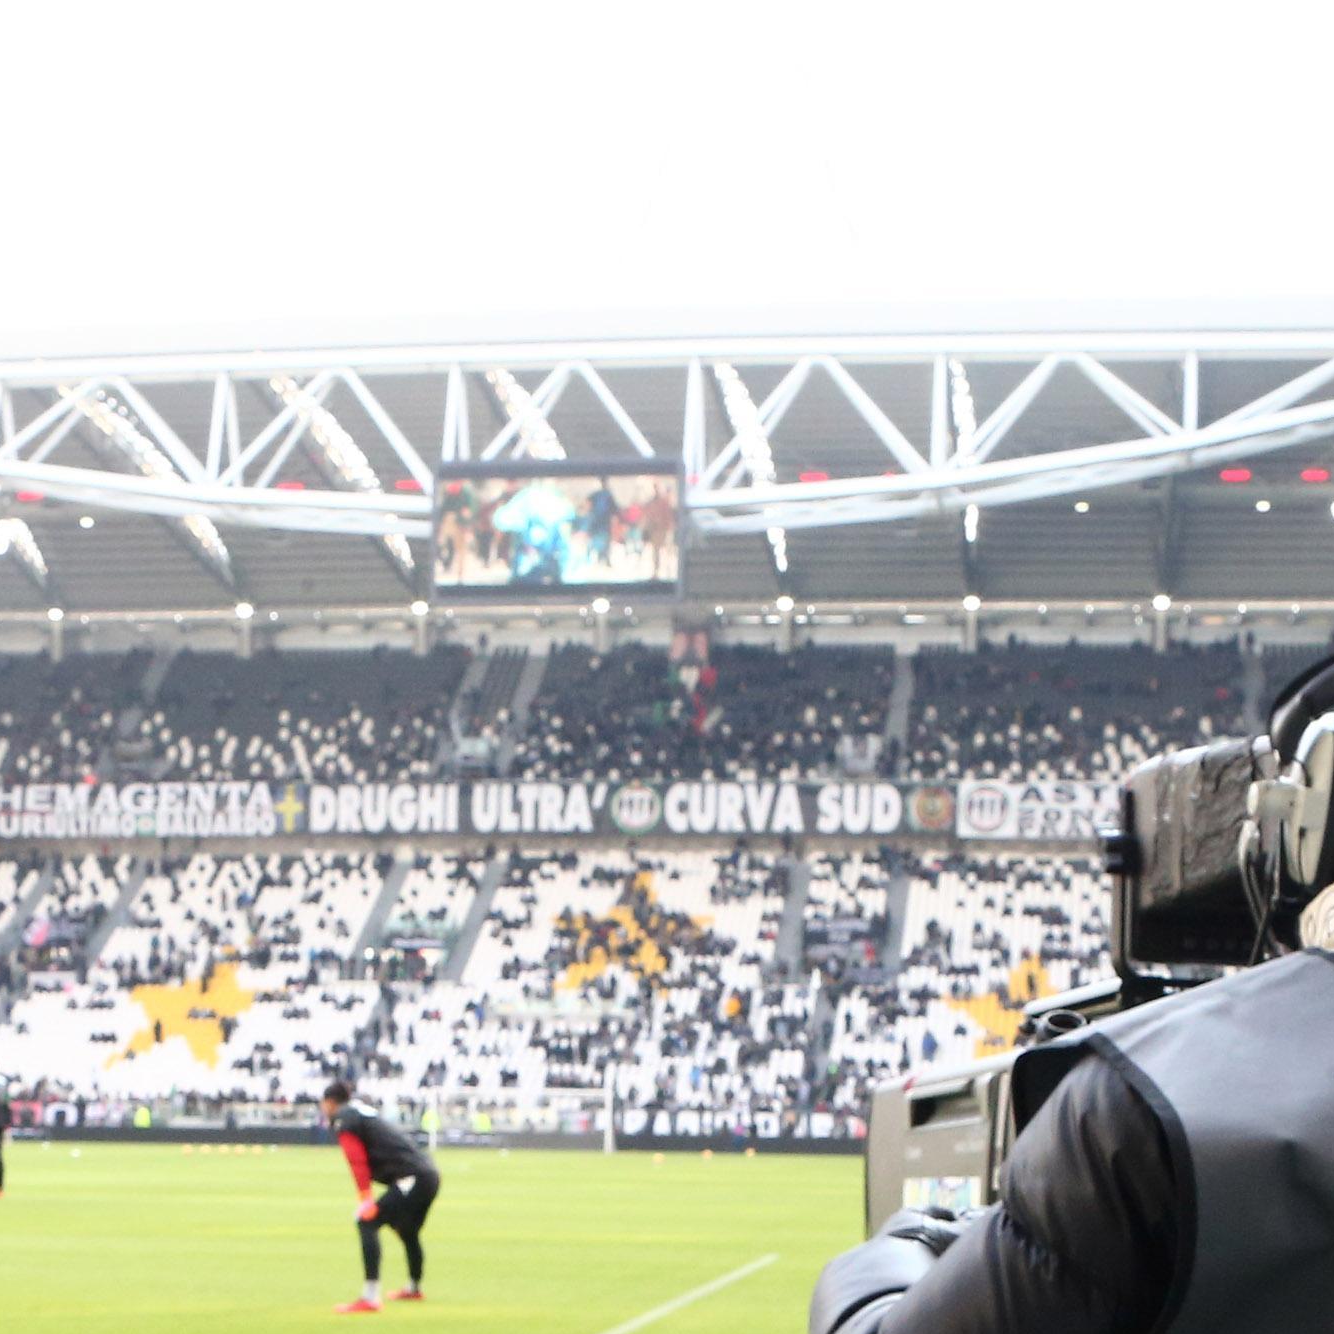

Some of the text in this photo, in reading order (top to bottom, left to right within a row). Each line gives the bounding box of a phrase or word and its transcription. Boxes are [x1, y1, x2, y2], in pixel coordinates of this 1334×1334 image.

[54, 782, 274, 815] MAGENTA
[310, 782, 459, 833] DRUGHI
[664, 782, 805, 834] CURVA
[816, 783, 902, 834] SUD
